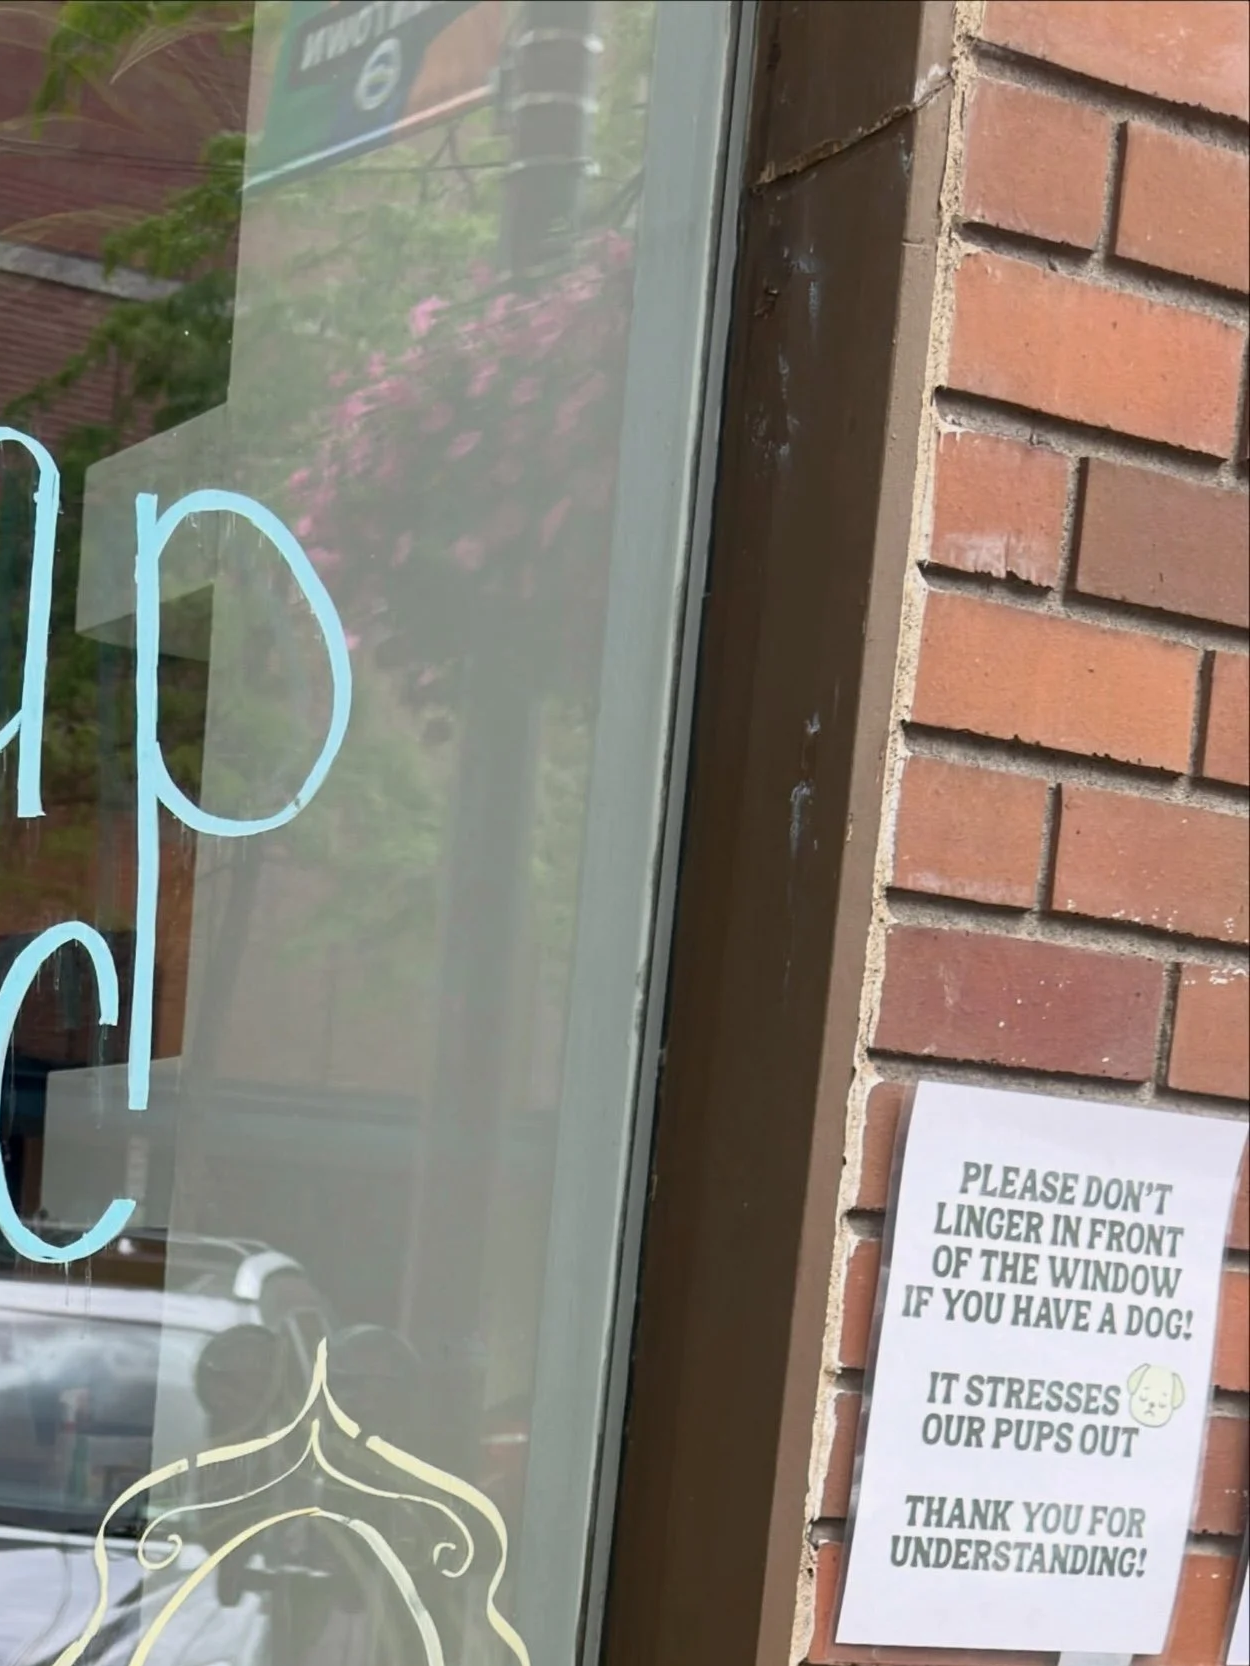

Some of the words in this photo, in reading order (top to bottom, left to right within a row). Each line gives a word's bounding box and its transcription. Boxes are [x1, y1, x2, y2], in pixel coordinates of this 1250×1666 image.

[959, 1161, 1079, 1206] PLEASE
[1082, 1175, 1173, 1216] DON'T
[933, 1201, 1044, 1245] LINGER
[1050, 1213, 1083, 1248] IN
[1087, 1217, 1185, 1258] FRONT
[932, 1244, 973, 1279] OF
[980, 1248, 1040, 1286] THE
[1047, 1255, 1183, 1299] WINDOW
[901, 1284, 934, 1318] IF
[942, 1287, 1006, 1325] YOU
[1010, 1294, 1092, 1332] HAVE
[1096, 1302, 1117, 1335] A
[1124, 1304, 1194, 1341] DOG!
[926, 1371, 961, 1405] IT
[964, 1374, 1121, 1416] STRESSES
[921, 1412, 986, 1449] OUR
[991, 1417, 1074, 1454] PUPS
[1079, 1423, 1140, 1458] OUT
[905, 1494, 1014, 1532] THANK
[1022, 1501, 1084, 1535] YOU
[1088, 1505, 1146, 1539] FOR
[890, 1534, 1148, 1578] UNDERSTANDING!
